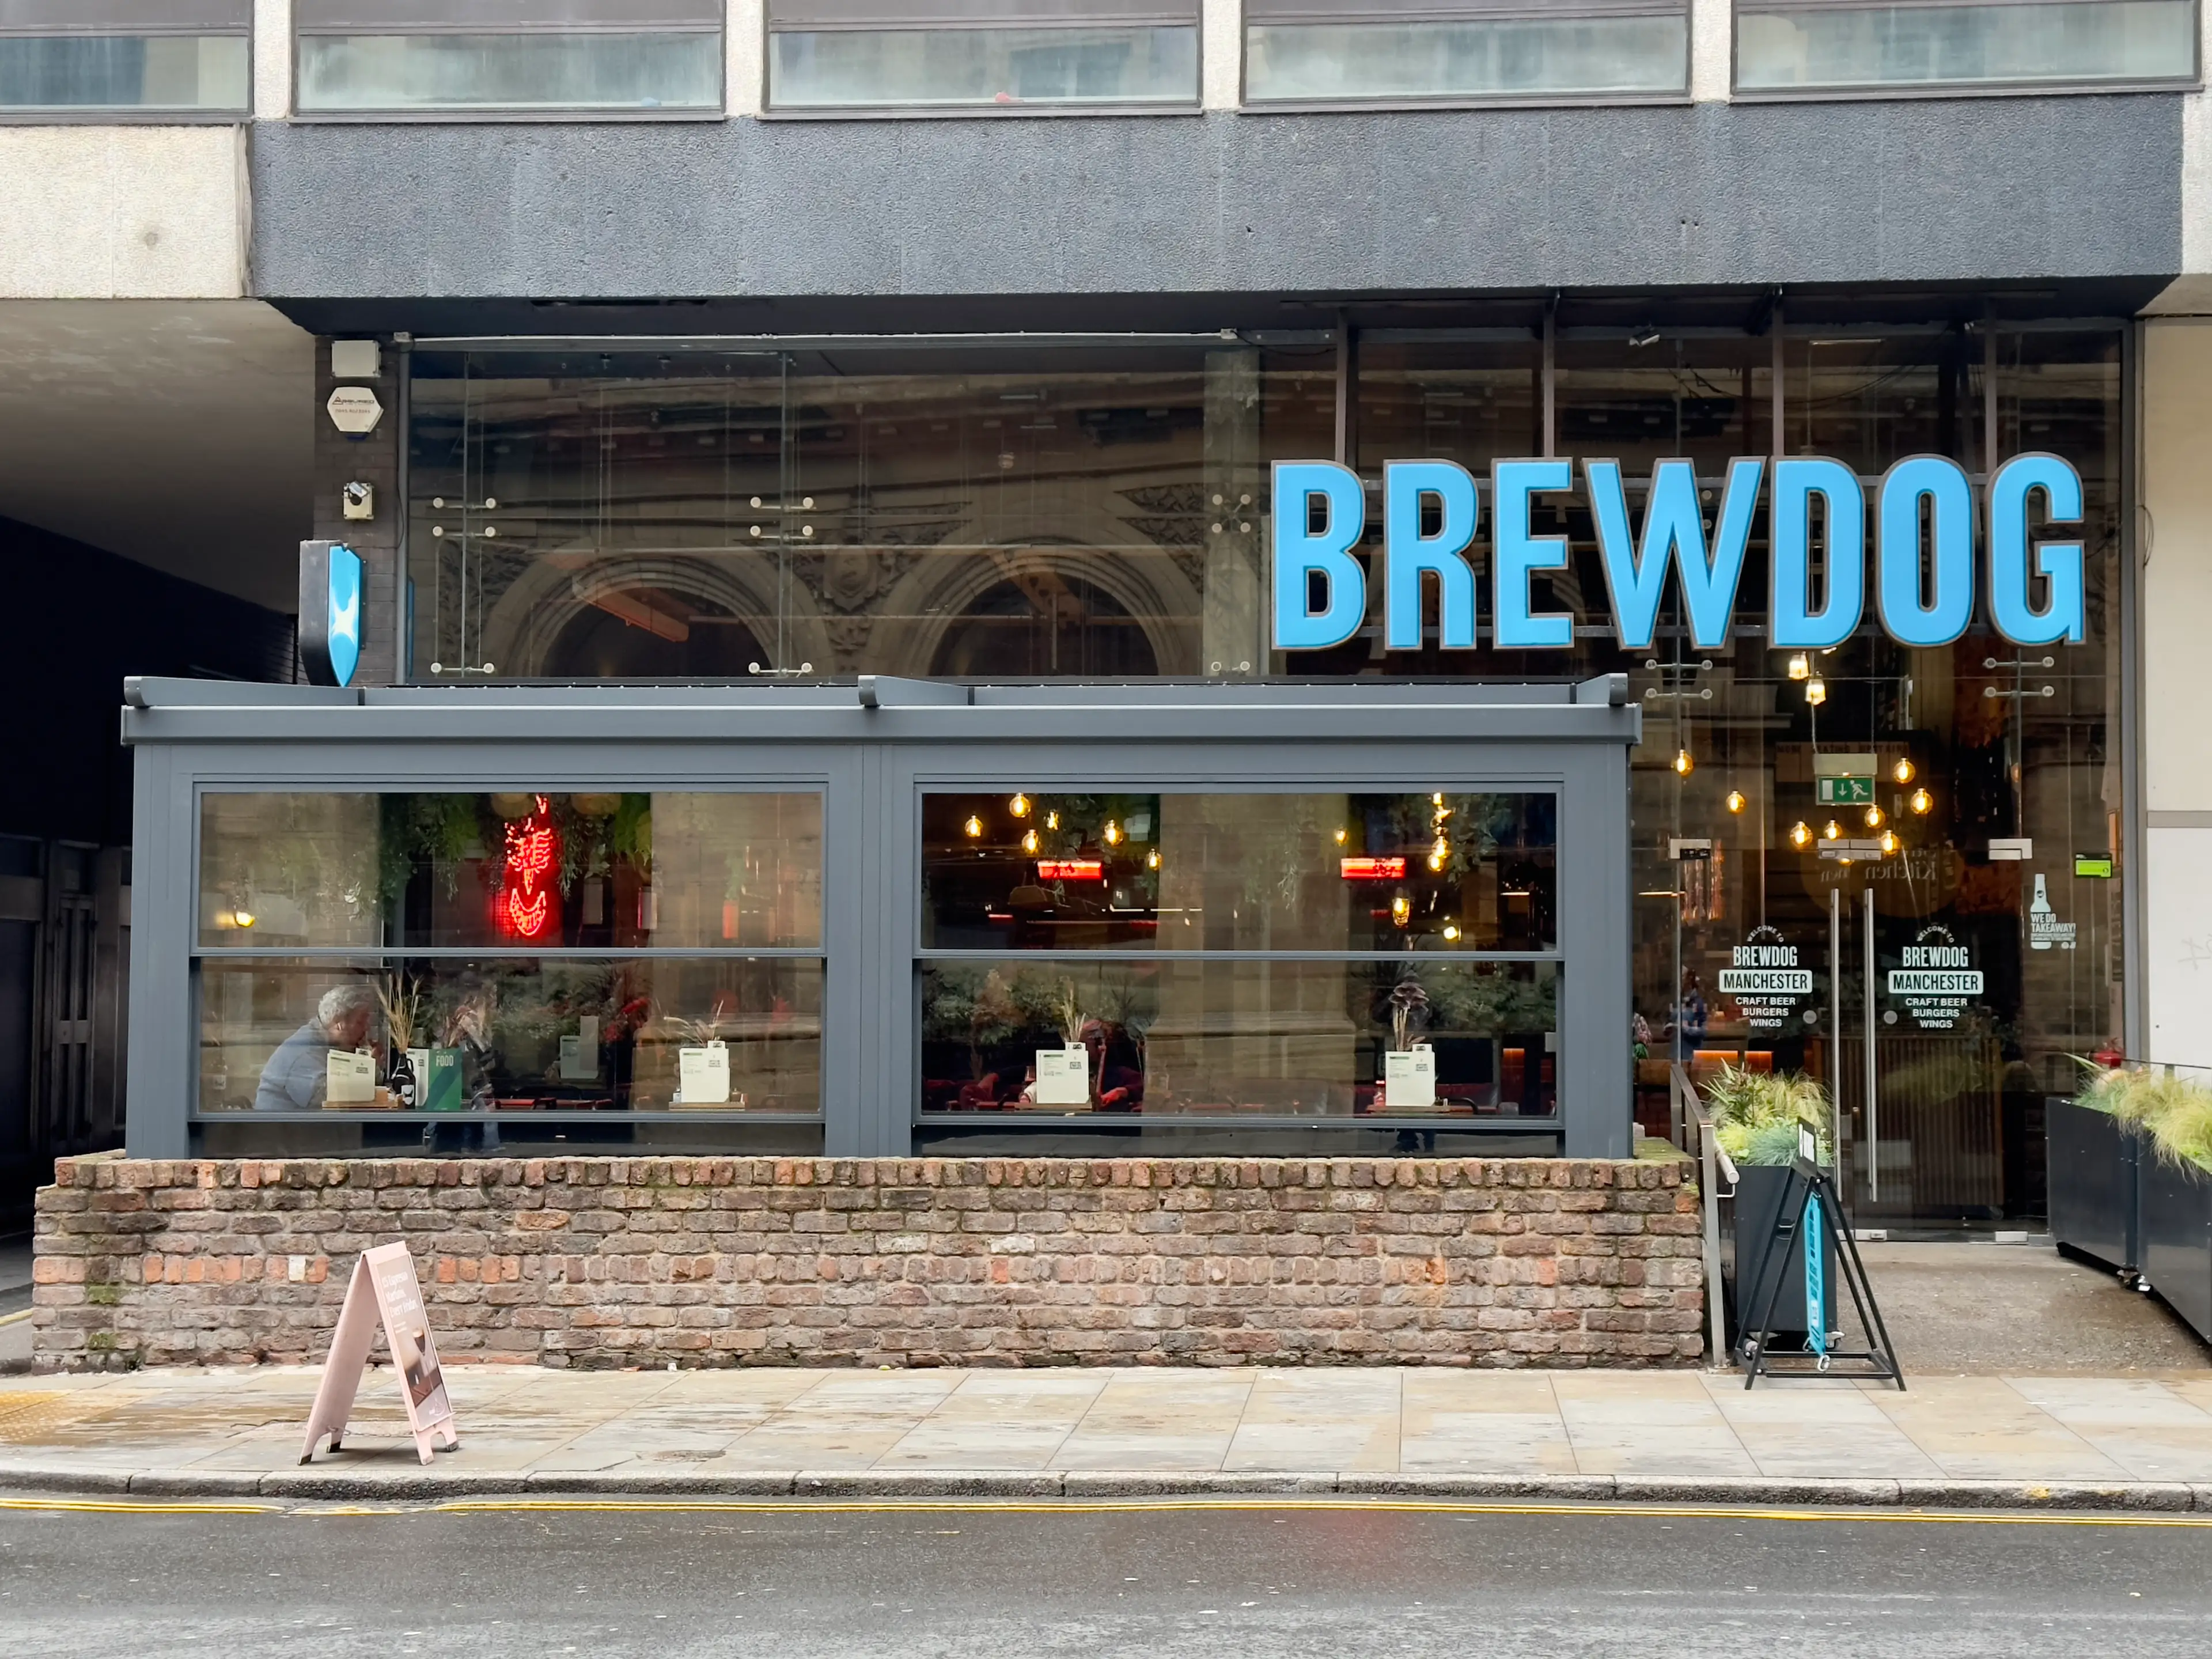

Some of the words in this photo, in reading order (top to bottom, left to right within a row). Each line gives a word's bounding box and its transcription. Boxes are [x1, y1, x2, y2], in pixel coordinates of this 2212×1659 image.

[1271, 454, 2086, 652] BREWDOG
[2031, 913, 2045, 923] WE
[2045, 913, 2056, 923] DO
[1747, 925, 1778, 942] WELCOME
[1776, 932, 1785, 943] TO
[1916, 925, 1948, 942] WELCOME
[1946, 933, 1955, 943] TO
[1733, 946, 1798, 967] BREWDOG
[1903, 946, 1969, 967] BREWDOG
[1724, 973, 1808, 989] MANCHESTER
[1893, 974, 1978, 990] MANCHESTER
[1735, 997, 1768, 1005] CRAFT
[1770, 997, 1796, 1005] BEER
[1906, 998, 1939, 1006] CRAFT
[1940, 998, 1968, 1006] BEER
[1743, 1008, 1789, 1016] BURGERS
[1912, 1009, 1960, 1017] BURGERS
[1749, 1018, 1782, 1027] WINGS
[1919, 1020, 1953, 1028] WINGS
[435, 1055, 454, 1066] FOOD
